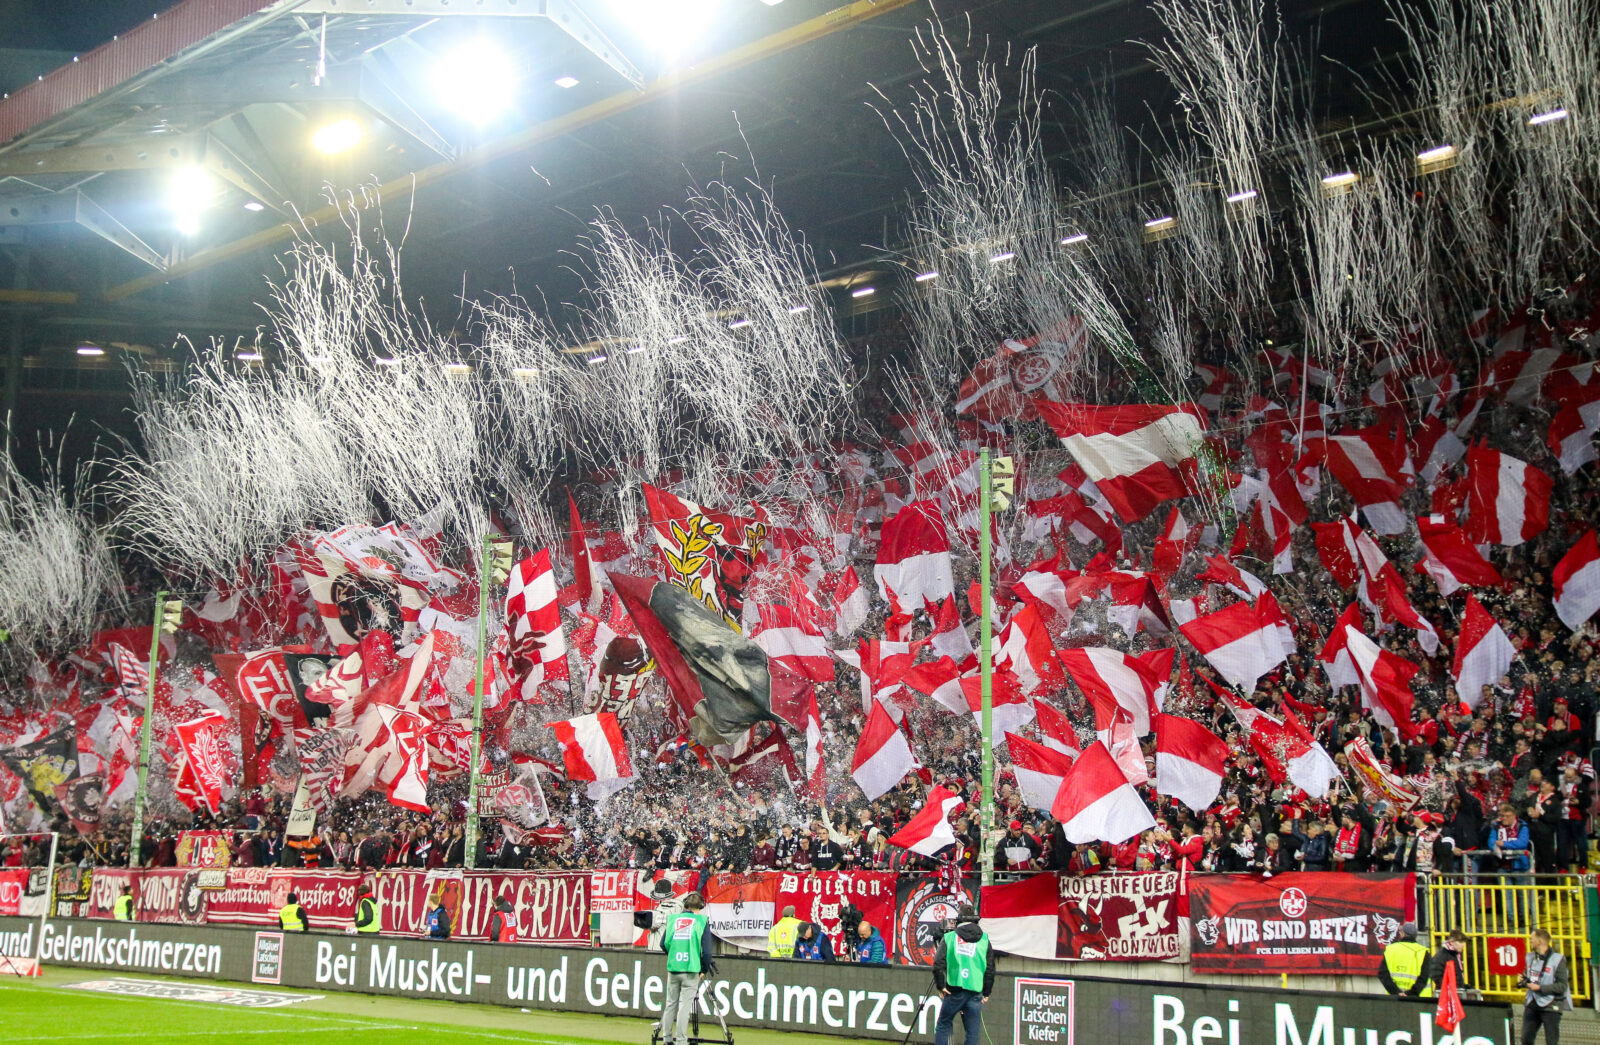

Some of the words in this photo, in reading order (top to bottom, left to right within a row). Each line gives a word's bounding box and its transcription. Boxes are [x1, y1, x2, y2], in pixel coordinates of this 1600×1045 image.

[137, 875, 180, 912] YOUTH
[780, 873, 881, 897] Division
[1224, 916, 1260, 945] WIR
[1262, 919, 1306, 941] SIND
[1309, 914, 1368, 946] BETZE
[40, 923, 222, 974] Gelenkschmerzen
[1110, 936, 1176, 954] CONTWIG
[1256, 947, 1272, 955] FCK
[1312, 946, 1336, 954] LANG
[1495, 944, 1518, 967] 10
[675, 952, 689, 962] 05
[961, 968, 969, 978] 6
[315, 940, 357, 986] Bei
[369, 944, 491, 996] Muskel-
[507, 955, 568, 1003] und
[584, 957, 943, 1035] Gelekschmerzen
[1022, 988, 1067, 1009] Allgäuer
[1021, 1007, 1067, 1025] Latschen
[1028, 1025, 1060, 1043] Kiefer
